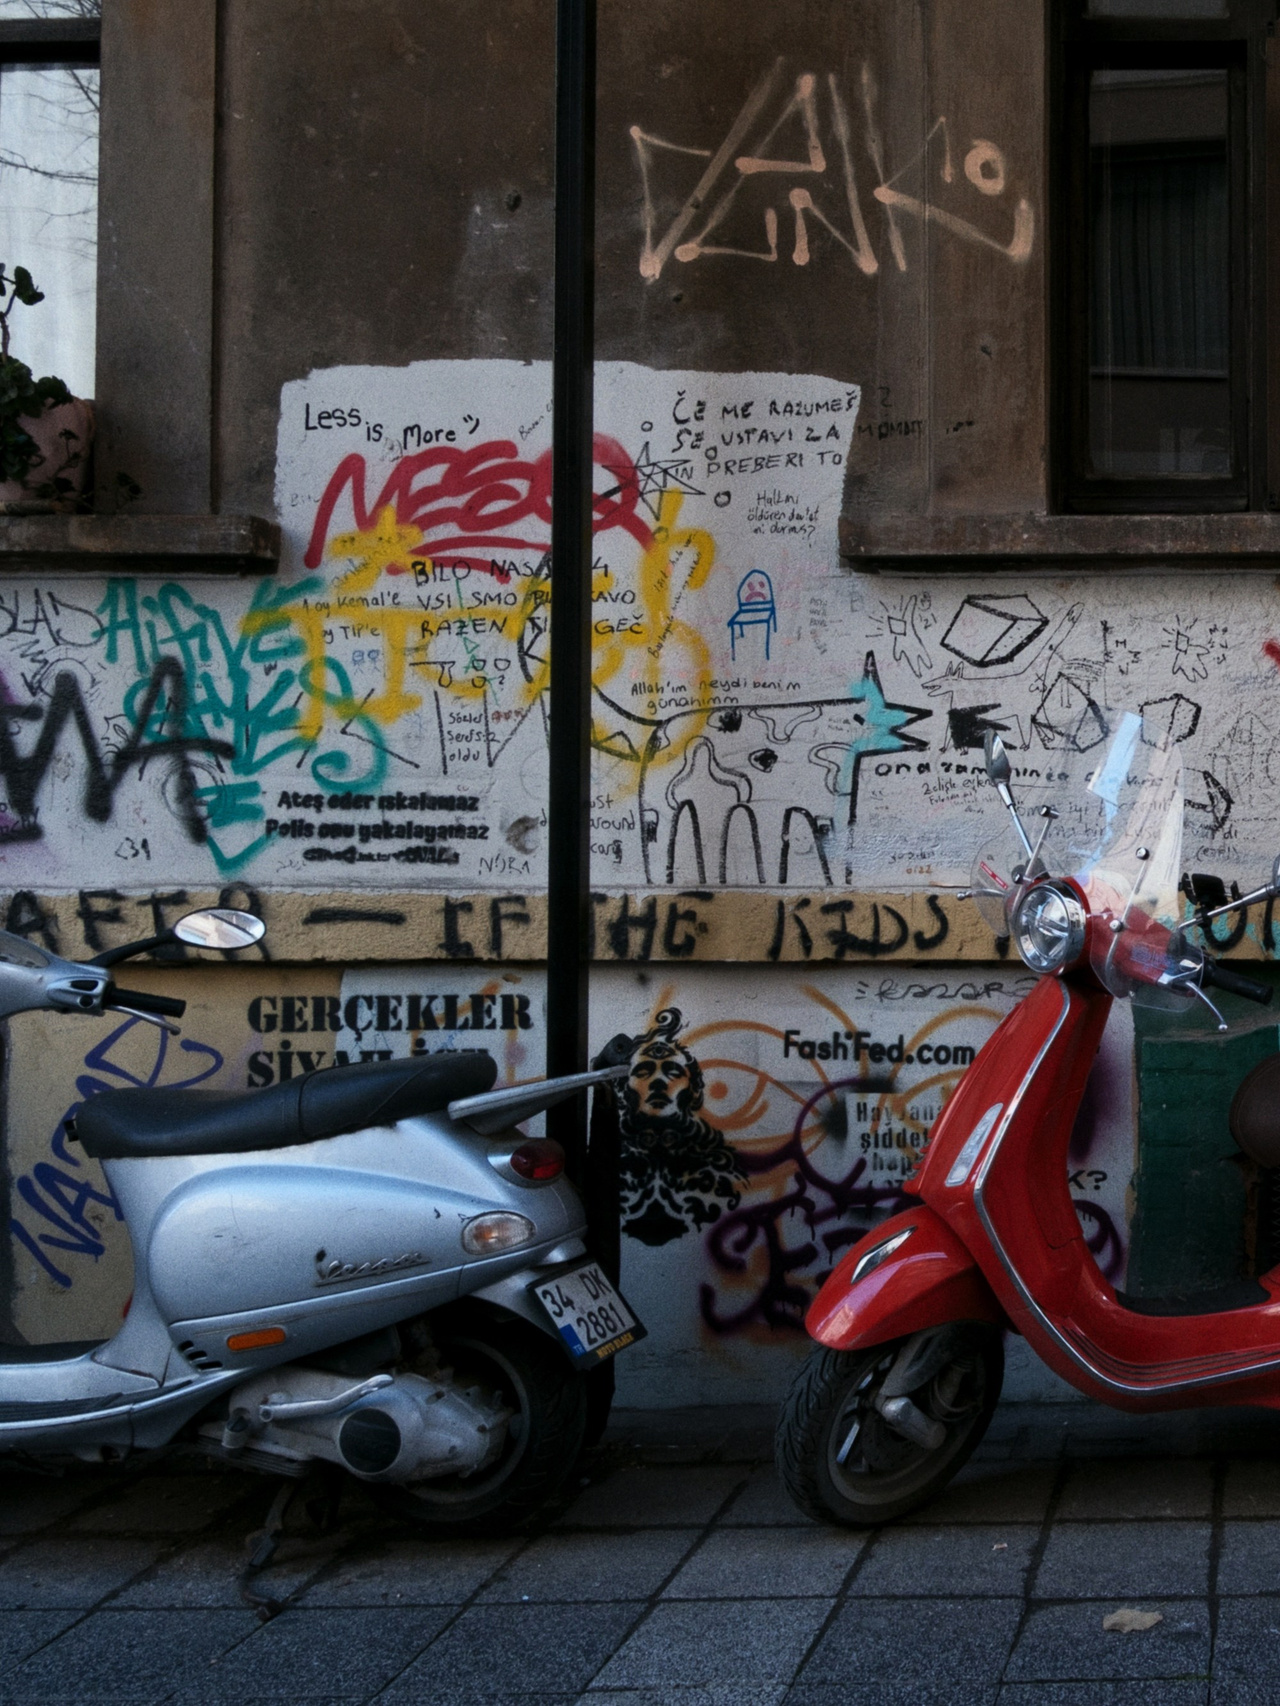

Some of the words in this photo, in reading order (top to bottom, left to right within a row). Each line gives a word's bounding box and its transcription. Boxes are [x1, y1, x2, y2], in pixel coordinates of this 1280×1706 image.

[721, 401, 754, 420] ME
[769, 390, 857, 417] RAZUMEŠ
[305, 402, 361, 430] Less
[366, 421, 383, 442] is
[403, 424, 457, 450] More
[721, 427, 793, 446] USTAVI
[707, 452, 803, 478] PREBERI
[817, 450, 842, 466] TO
[411, 560, 471, 587] BILO
[417, 594, 451, 611] VSI
[467, 591, 517, 610] SMO
[421, 616, 508, 638] RAZEN
[449, 747, 480, 762] oldu
[247, 994, 534, 1041] GERÇEKLER
[542, 1284, 575, 1317] 34
[579, 1268, 612, 1300] DK
[576, 1302, 626, 1346] 2881
